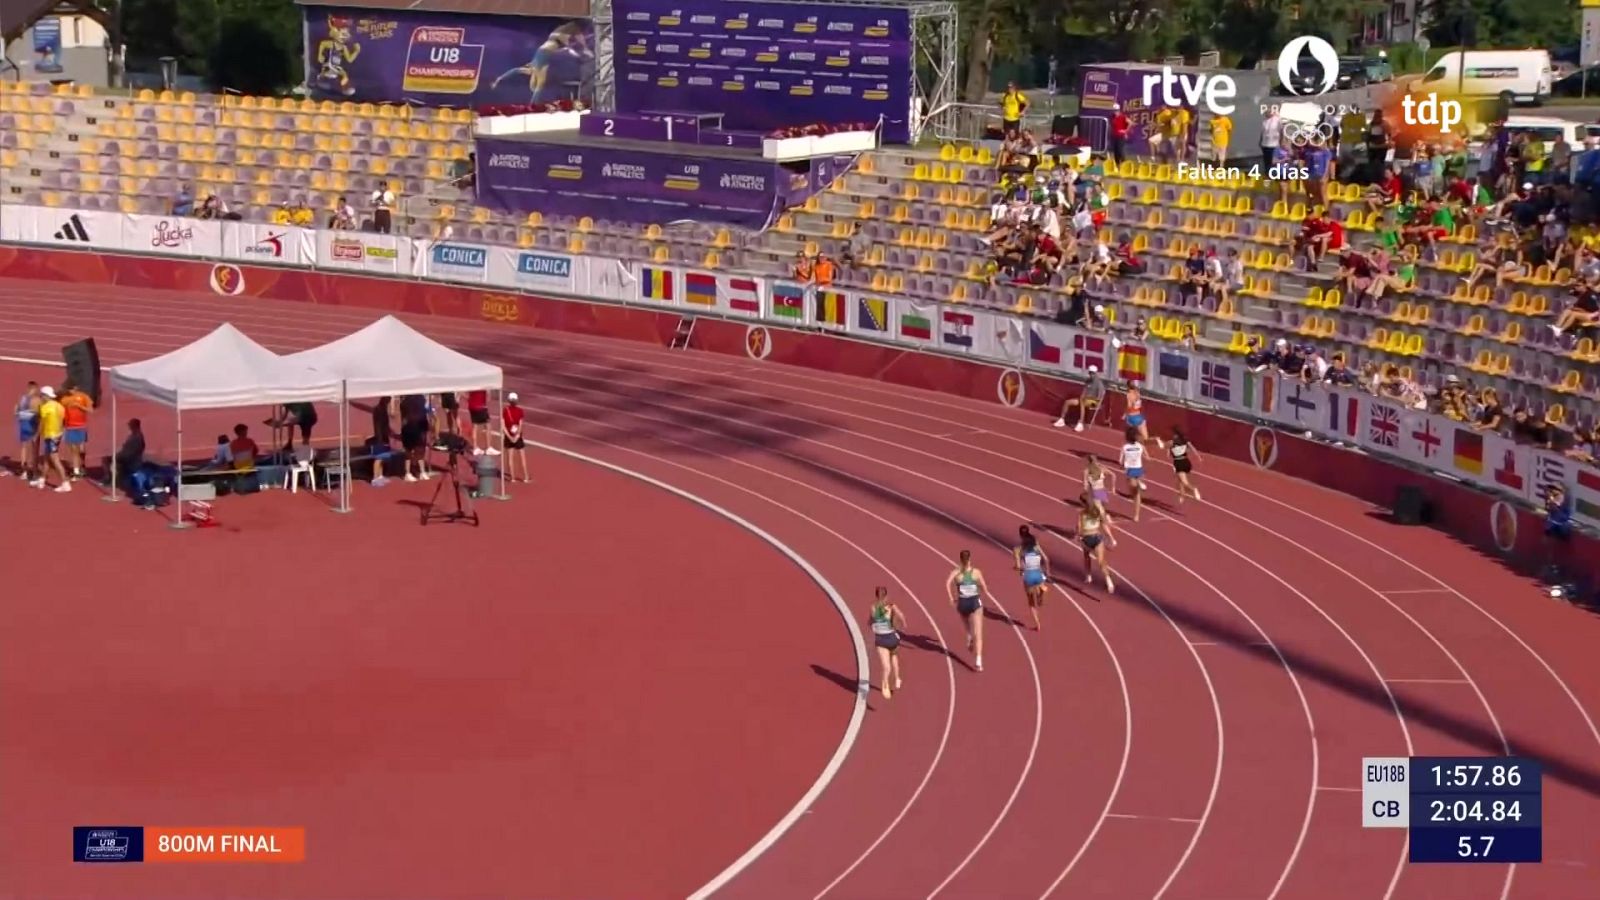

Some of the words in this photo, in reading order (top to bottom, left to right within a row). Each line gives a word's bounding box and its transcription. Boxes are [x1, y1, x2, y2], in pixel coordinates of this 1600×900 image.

[430, 47, 460, 64] U18
[409, 67, 476, 79] CHAMPIONSHIPS
[1094, 83, 1108, 93] U18
[604, 119, 614, 135] 2
[663, 116, 673, 140] 1
[727, 136, 733, 145] 3
[498, 154, 530, 162] EUROPEAN
[568, 154, 582, 163] U18
[611, 163, 645, 172] EUROPEAN
[684, 165, 700, 174] U18
[611, 171, 645, 179] ATHLETICS
[731, 174, 764, 183] EUROPEAN
[730, 181, 764, 190] ATHLETICS
[441, 247, 483, 265] CONICA
[525, 257, 568, 274] CONICA
[482, 300, 518, 316] DUKLA
